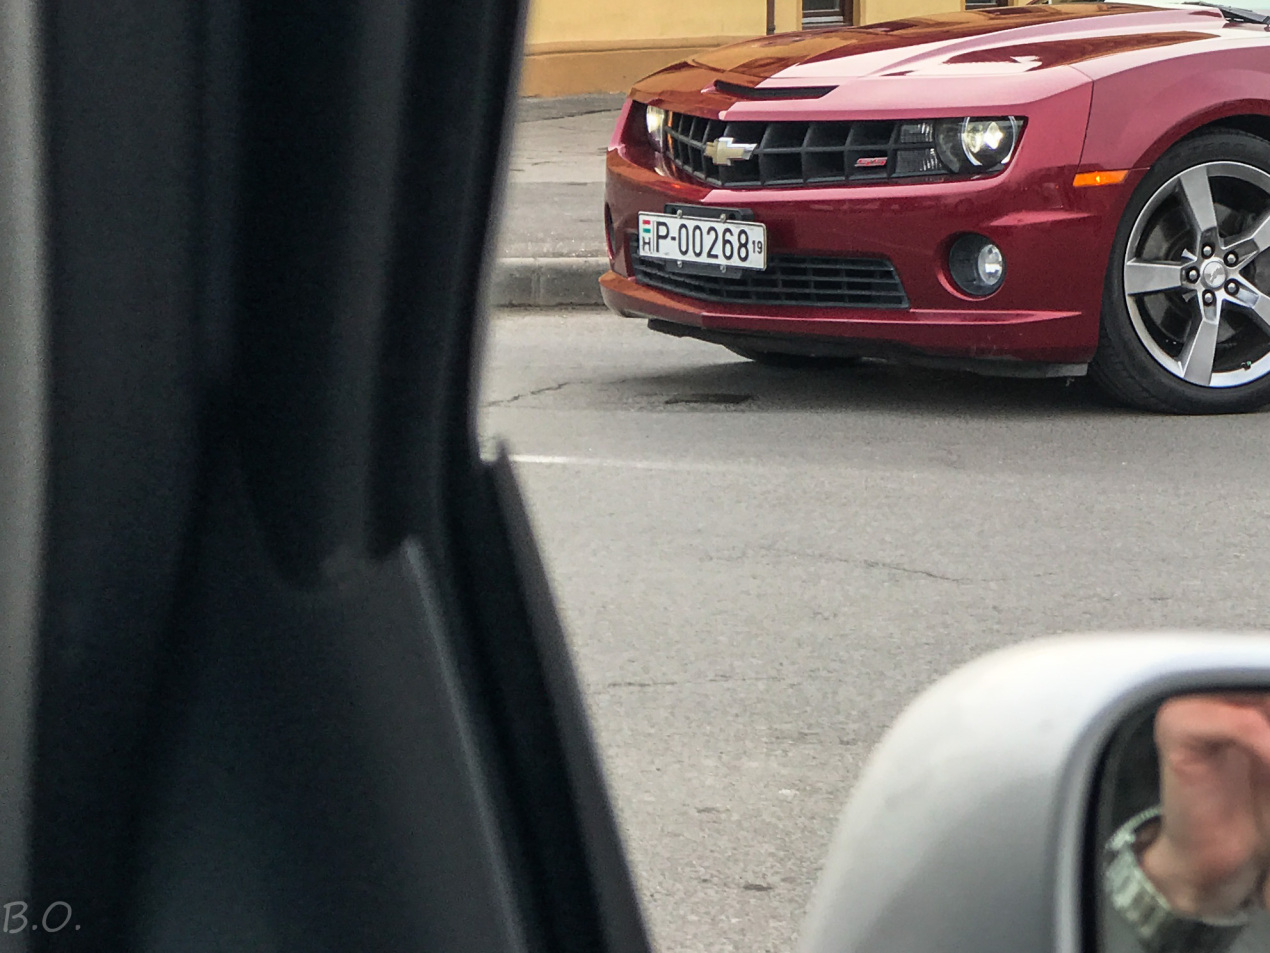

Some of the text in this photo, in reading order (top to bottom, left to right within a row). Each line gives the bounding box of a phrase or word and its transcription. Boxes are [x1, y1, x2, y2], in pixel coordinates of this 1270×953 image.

[642, 236, 651, 252] H
[655, 221, 763, 262] P-00268 19
